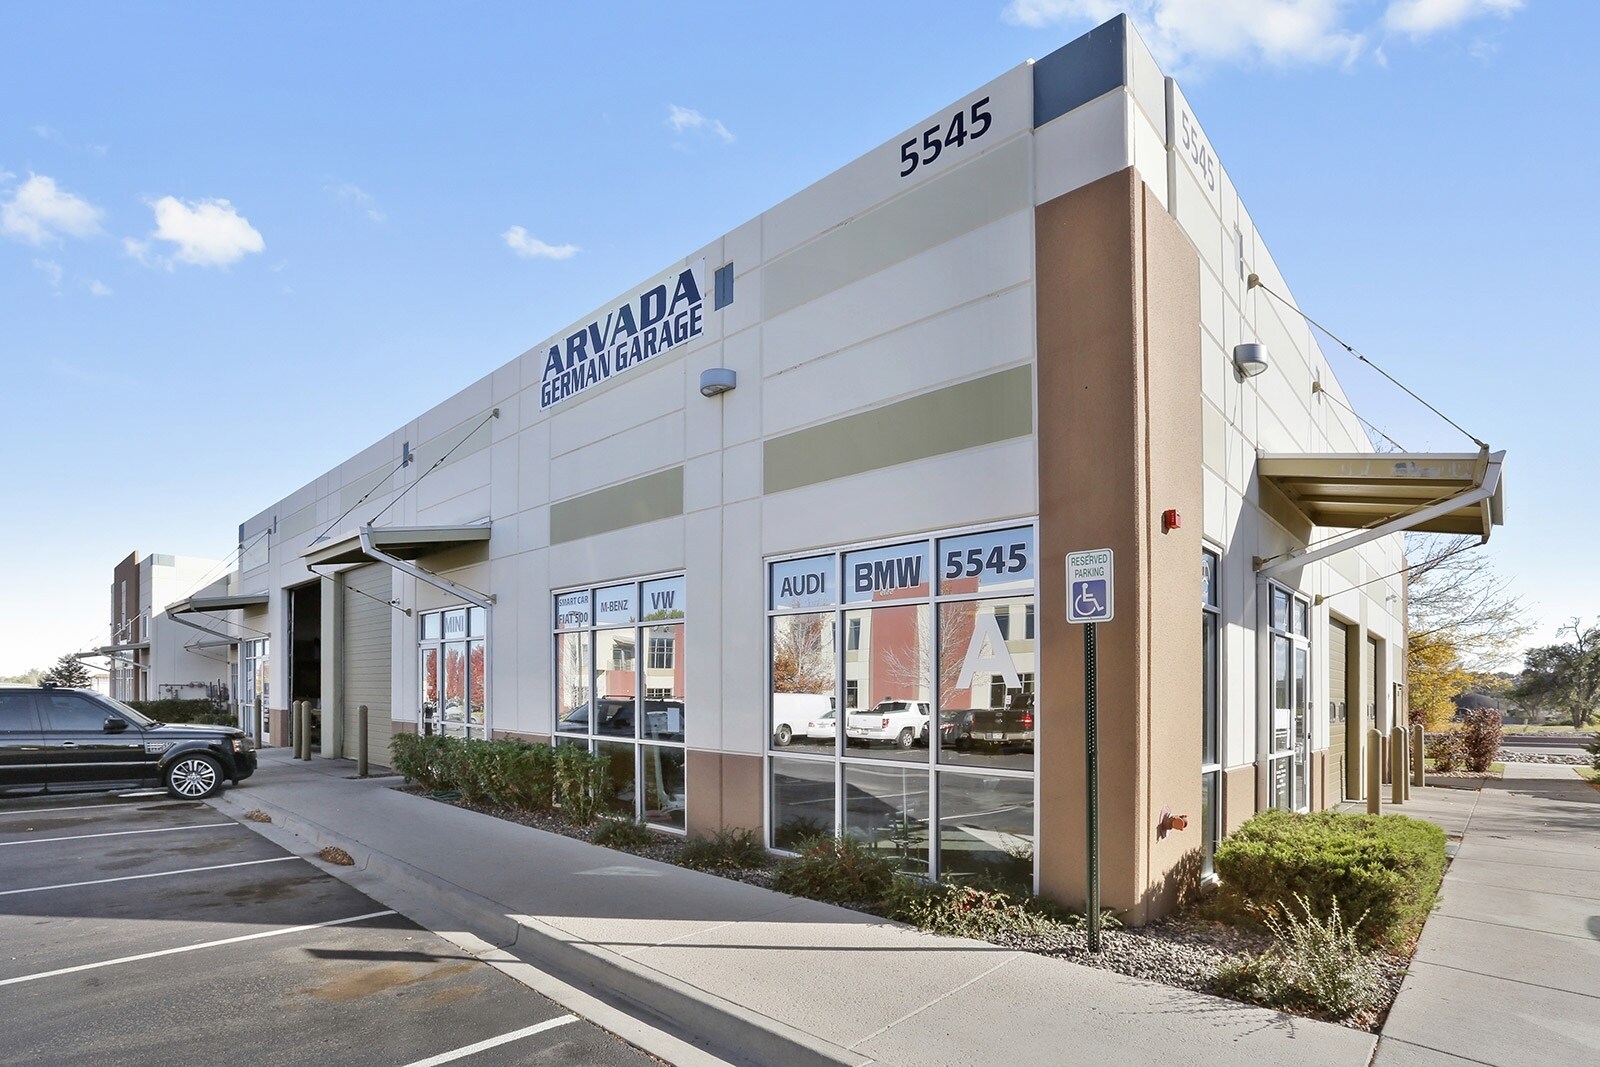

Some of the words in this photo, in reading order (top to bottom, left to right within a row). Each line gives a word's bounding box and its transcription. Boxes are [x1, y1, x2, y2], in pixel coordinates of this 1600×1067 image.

[900, 96, 992, 177] 5545
[1181, 109, 1215, 192] 5545
[542, 268, 702, 382] ARVADA
[541, 350, 611, 408] GERMAN
[615, 303, 703, 371] GARAGE
[945, 543, 1027, 579] 5545
[1071, 553, 1108, 567] RESERVED
[1074, 566, 1105, 578] PARKING
[780, 572, 825, 597] AUDI
[854, 555, 922, 593] BMW
[559, 597, 577, 607] SMART
[577, 595, 589, 604] CAR
[600, 599, 629, 613] M-BENZ
[651, 590, 675, 610] VW
[445, 615, 464, 633] MINI
[559, 613, 574, 625] FIAT
[575, 612, 589, 623] 500
[955, 613, 1022, 689] A
